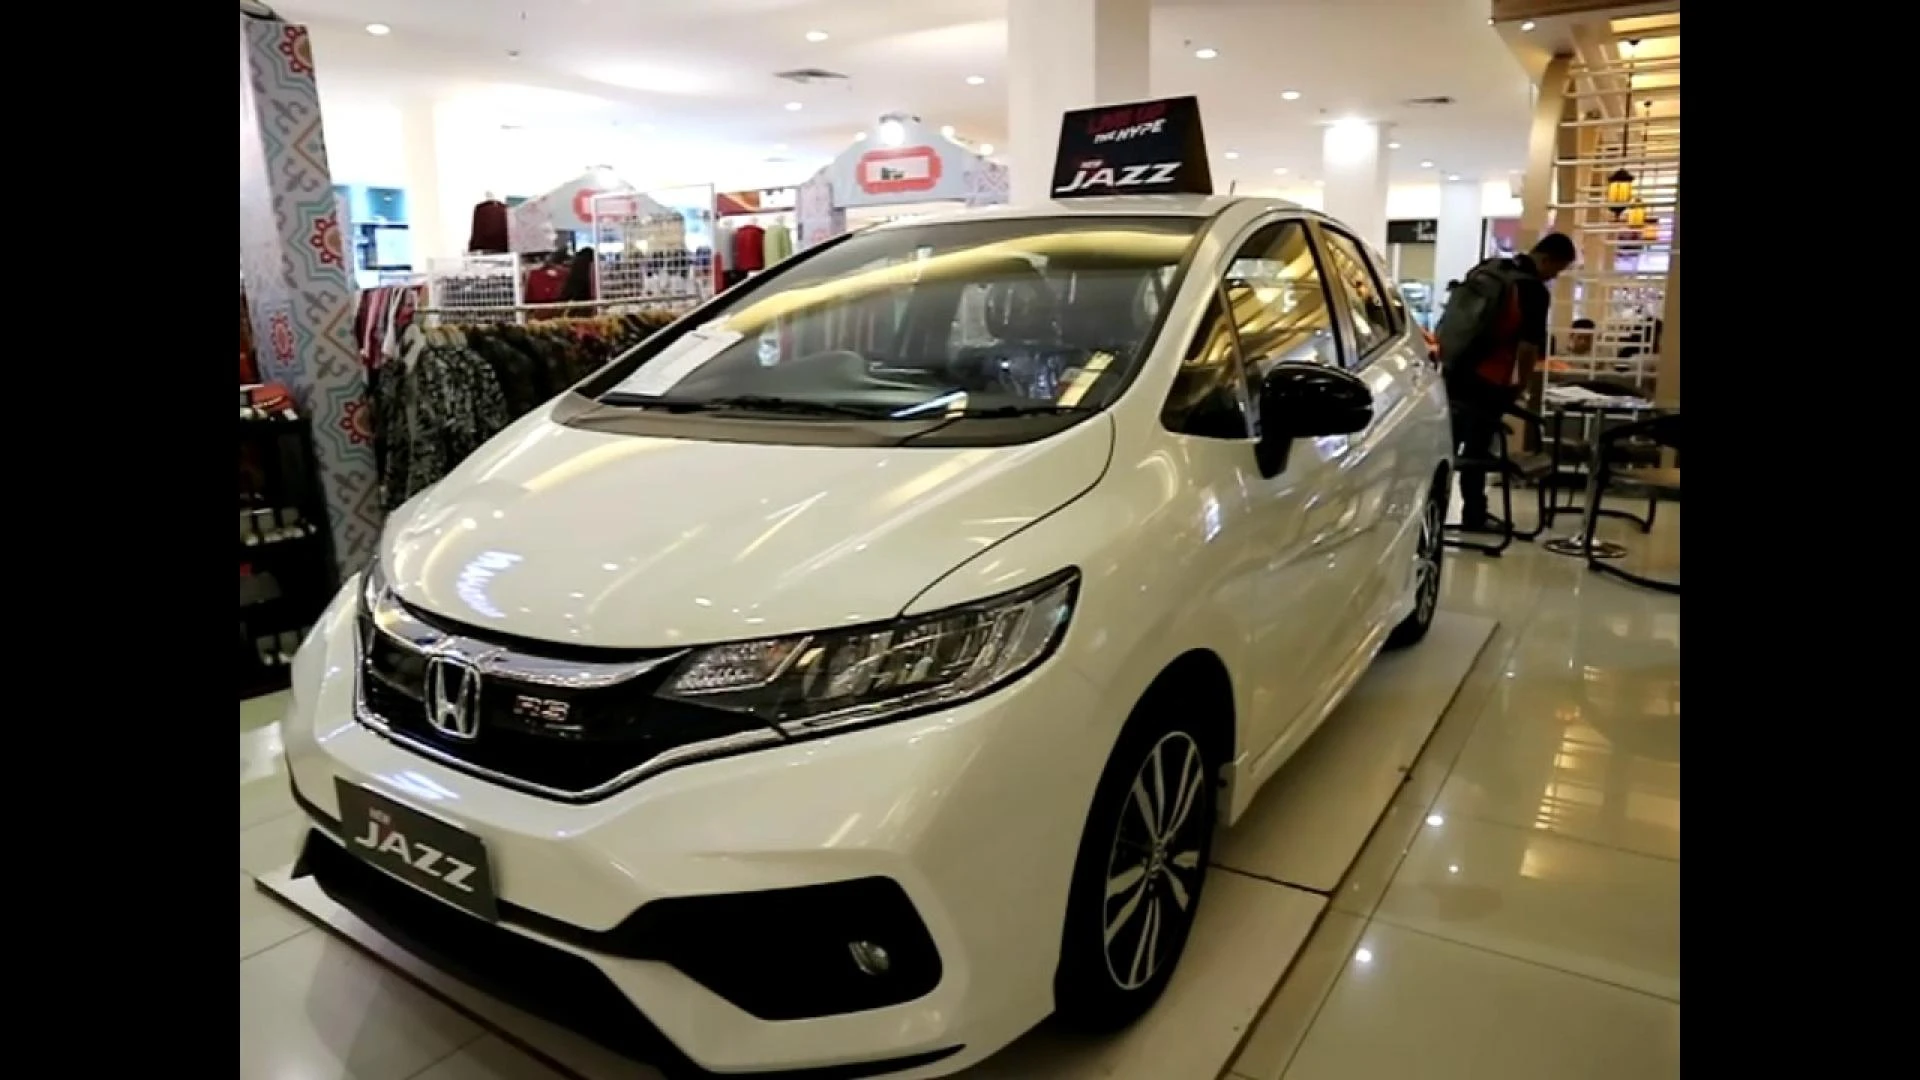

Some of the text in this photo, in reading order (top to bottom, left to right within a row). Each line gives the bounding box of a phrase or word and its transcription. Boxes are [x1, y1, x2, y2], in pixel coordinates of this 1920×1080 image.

[1115, 118, 1167, 142] HYPE
[1055, 162, 1182, 193] JAZZ
[355, 821, 477, 892] JAZZ
